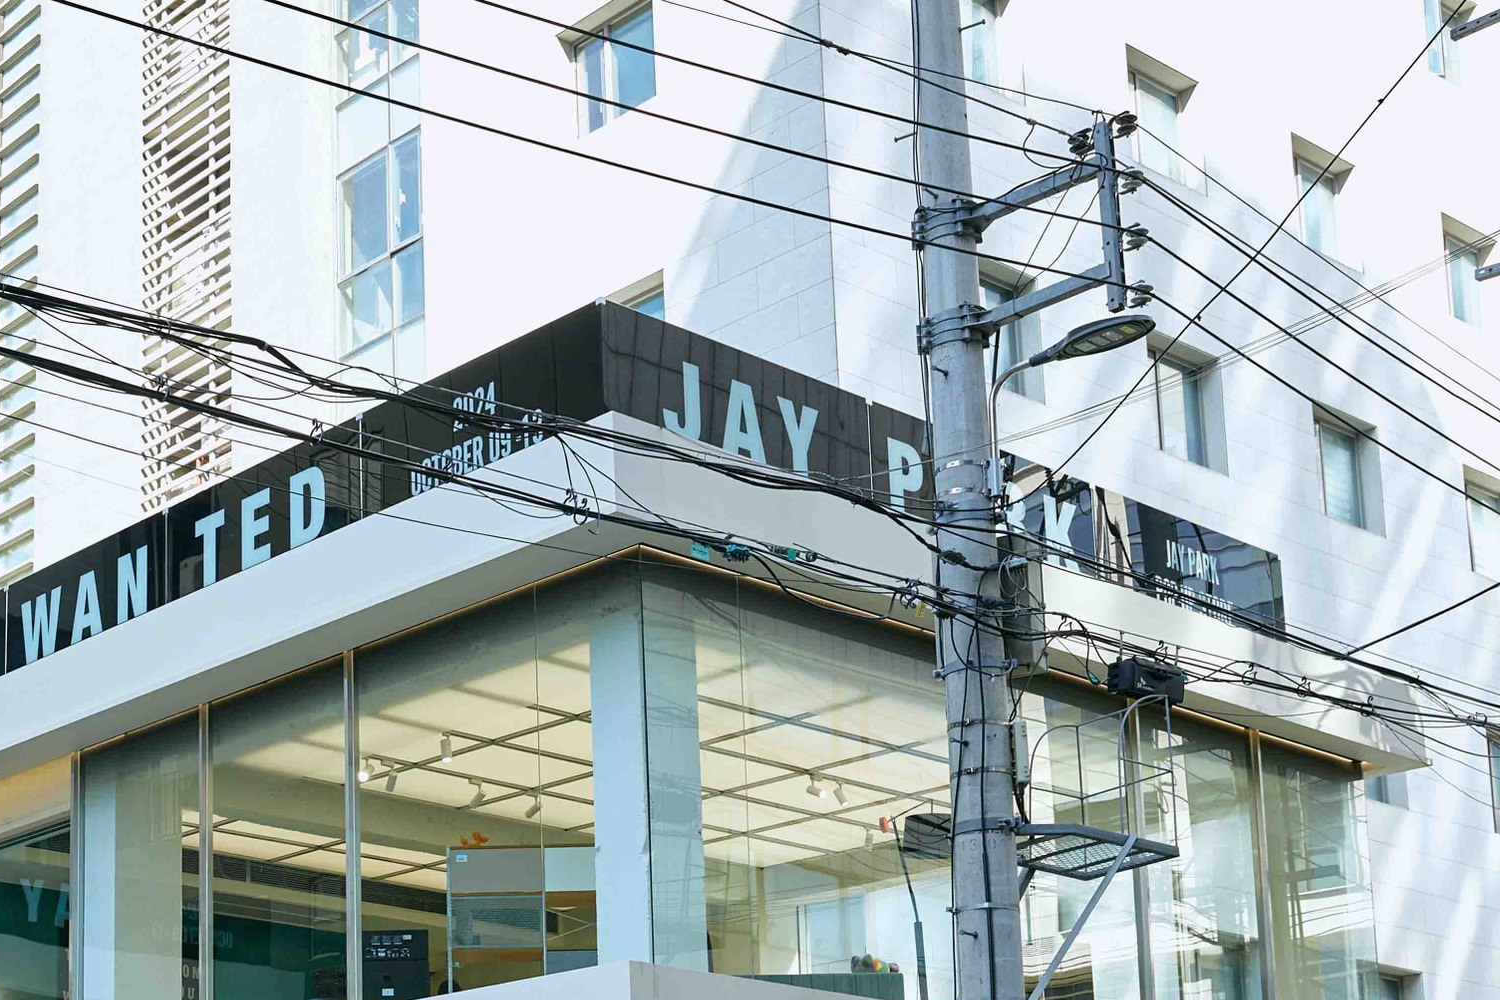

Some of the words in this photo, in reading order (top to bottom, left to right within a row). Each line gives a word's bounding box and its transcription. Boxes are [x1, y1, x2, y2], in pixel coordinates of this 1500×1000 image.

[663, 360, 818, 476] JAY
[886, 436, 1081, 574] PRK
[1166, 539, 1185, 576] JAY
[1187, 547, 1220, 586] PARK
